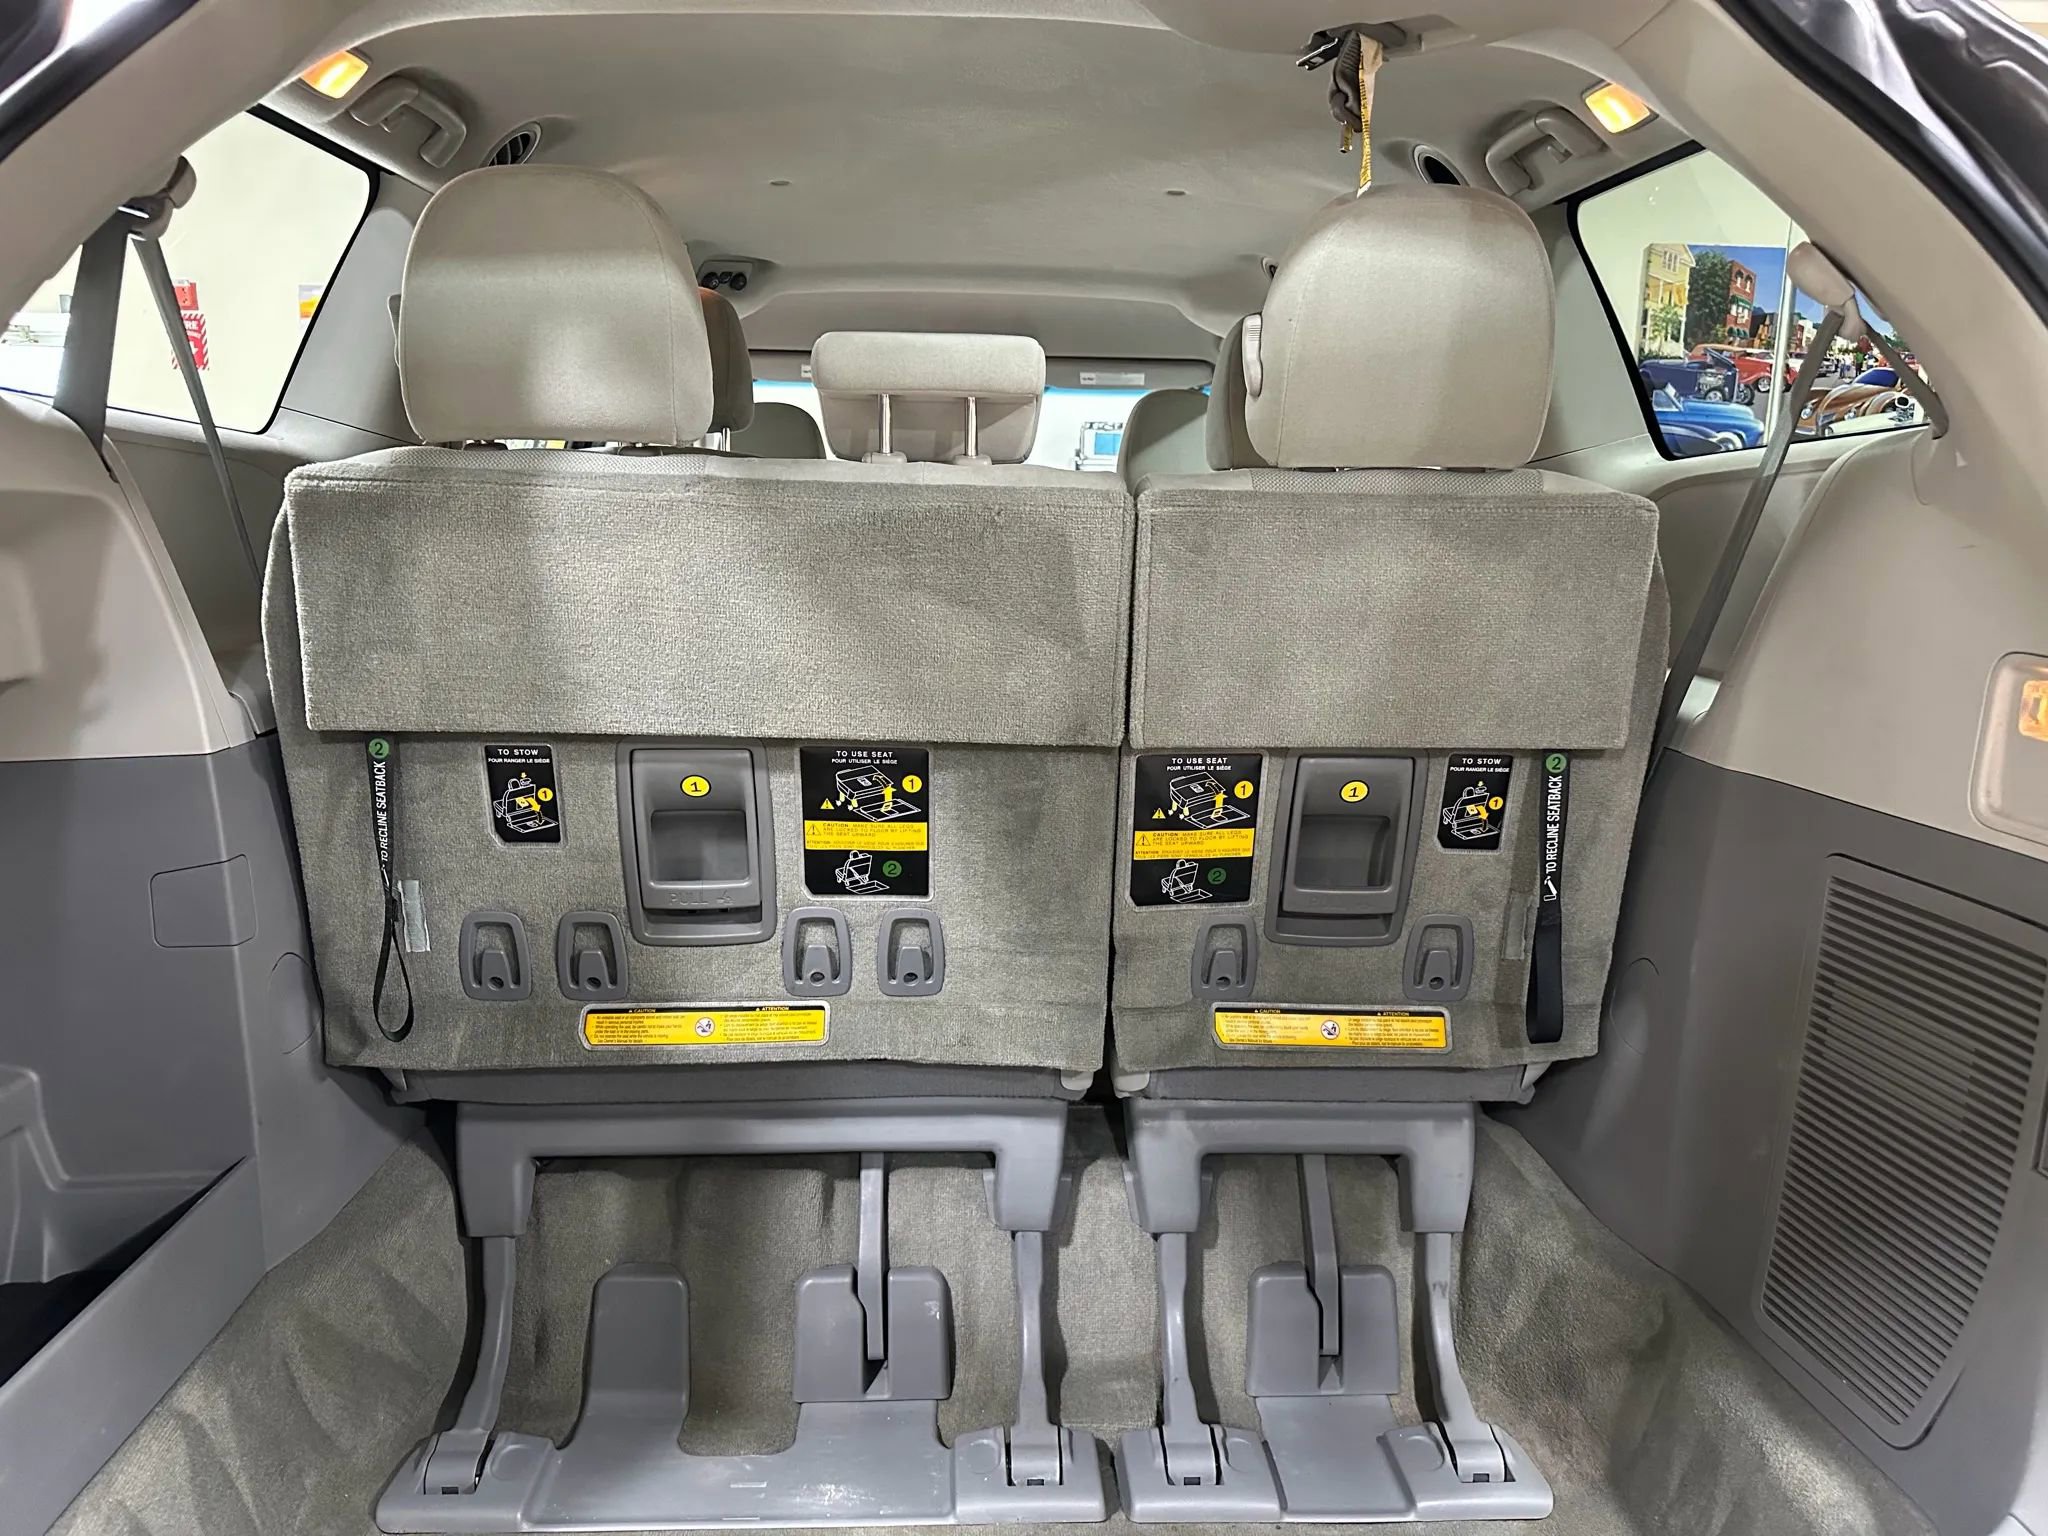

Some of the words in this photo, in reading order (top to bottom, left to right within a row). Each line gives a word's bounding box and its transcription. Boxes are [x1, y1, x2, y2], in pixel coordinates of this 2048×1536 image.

[374, 742, 383, 756] 2
[497, 748, 510, 756] TO
[513, 748, 539, 756] STOW
[1552, 757, 1561, 771] 2
[373, 761, 387, 810] SEATBACK
[1546, 775, 1562, 822] SEATBACK
[376, 810, 388, 850] RECLINE
[1545, 823, 1560, 860] RECLINE
[381, 850, 389, 862] TO
[1545, 861, 1556, 874] TO
